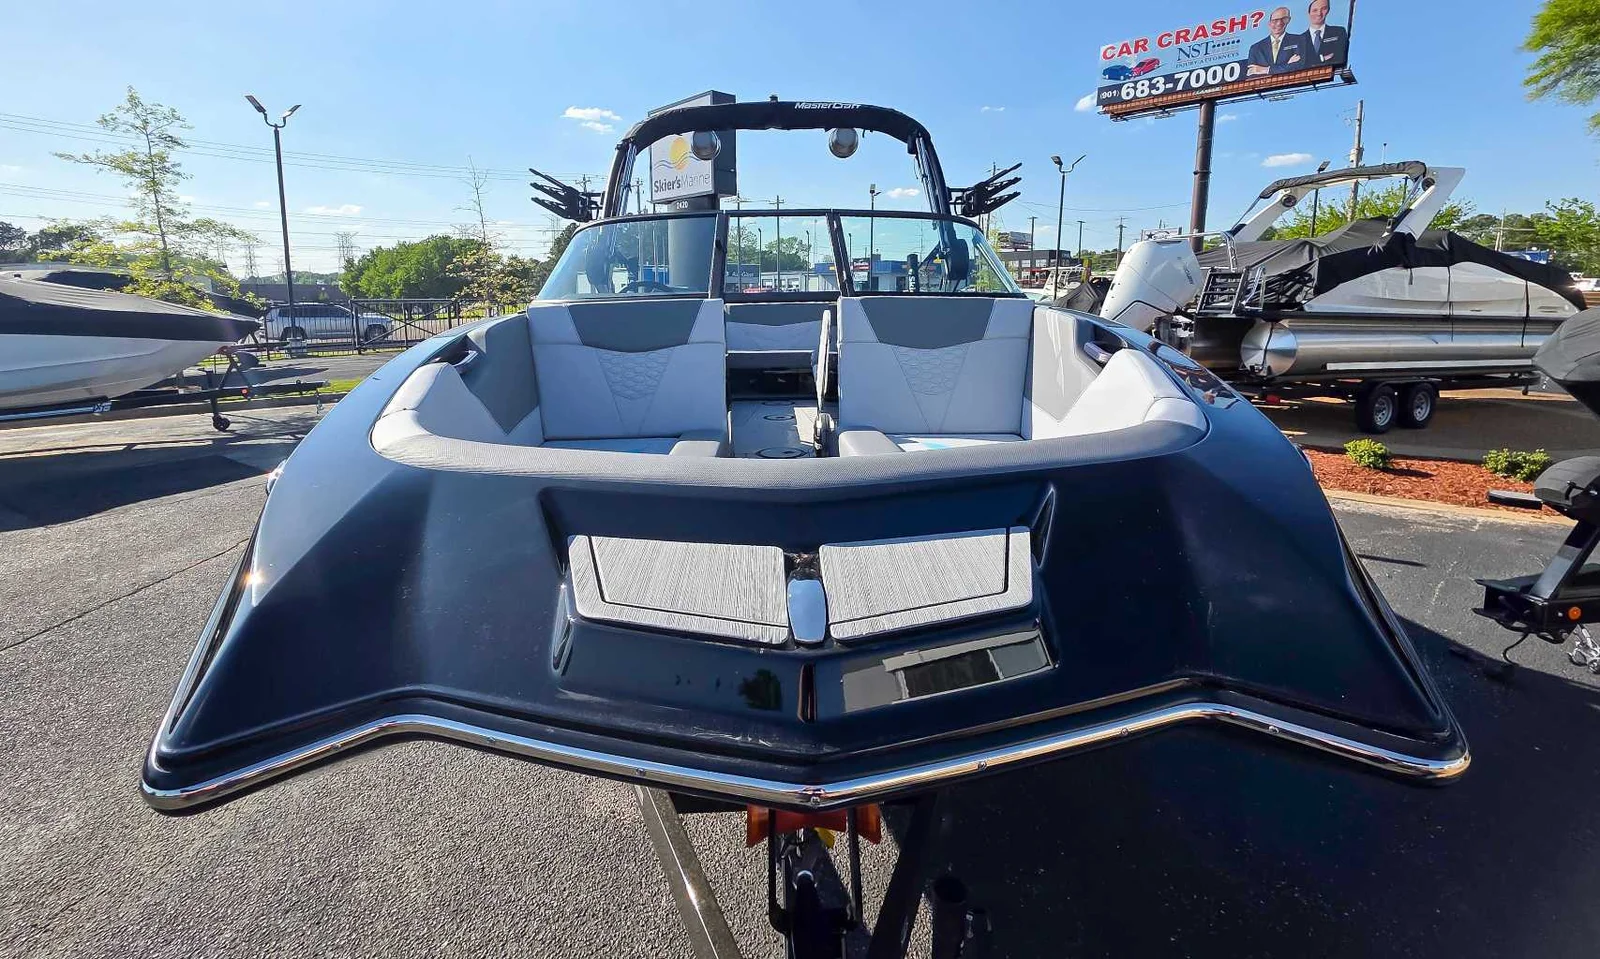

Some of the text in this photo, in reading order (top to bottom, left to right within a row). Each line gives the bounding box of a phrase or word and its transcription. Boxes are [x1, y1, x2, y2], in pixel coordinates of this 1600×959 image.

[1101, 11, 1265, 60] CAR CRASH?
[1177, 41, 1214, 61] NST
[1100, 62, 1240, 100] (901) 683-7000
[794, 102, 862, 110] MasterCraft
[654, 175, 681, 193] Skier's
